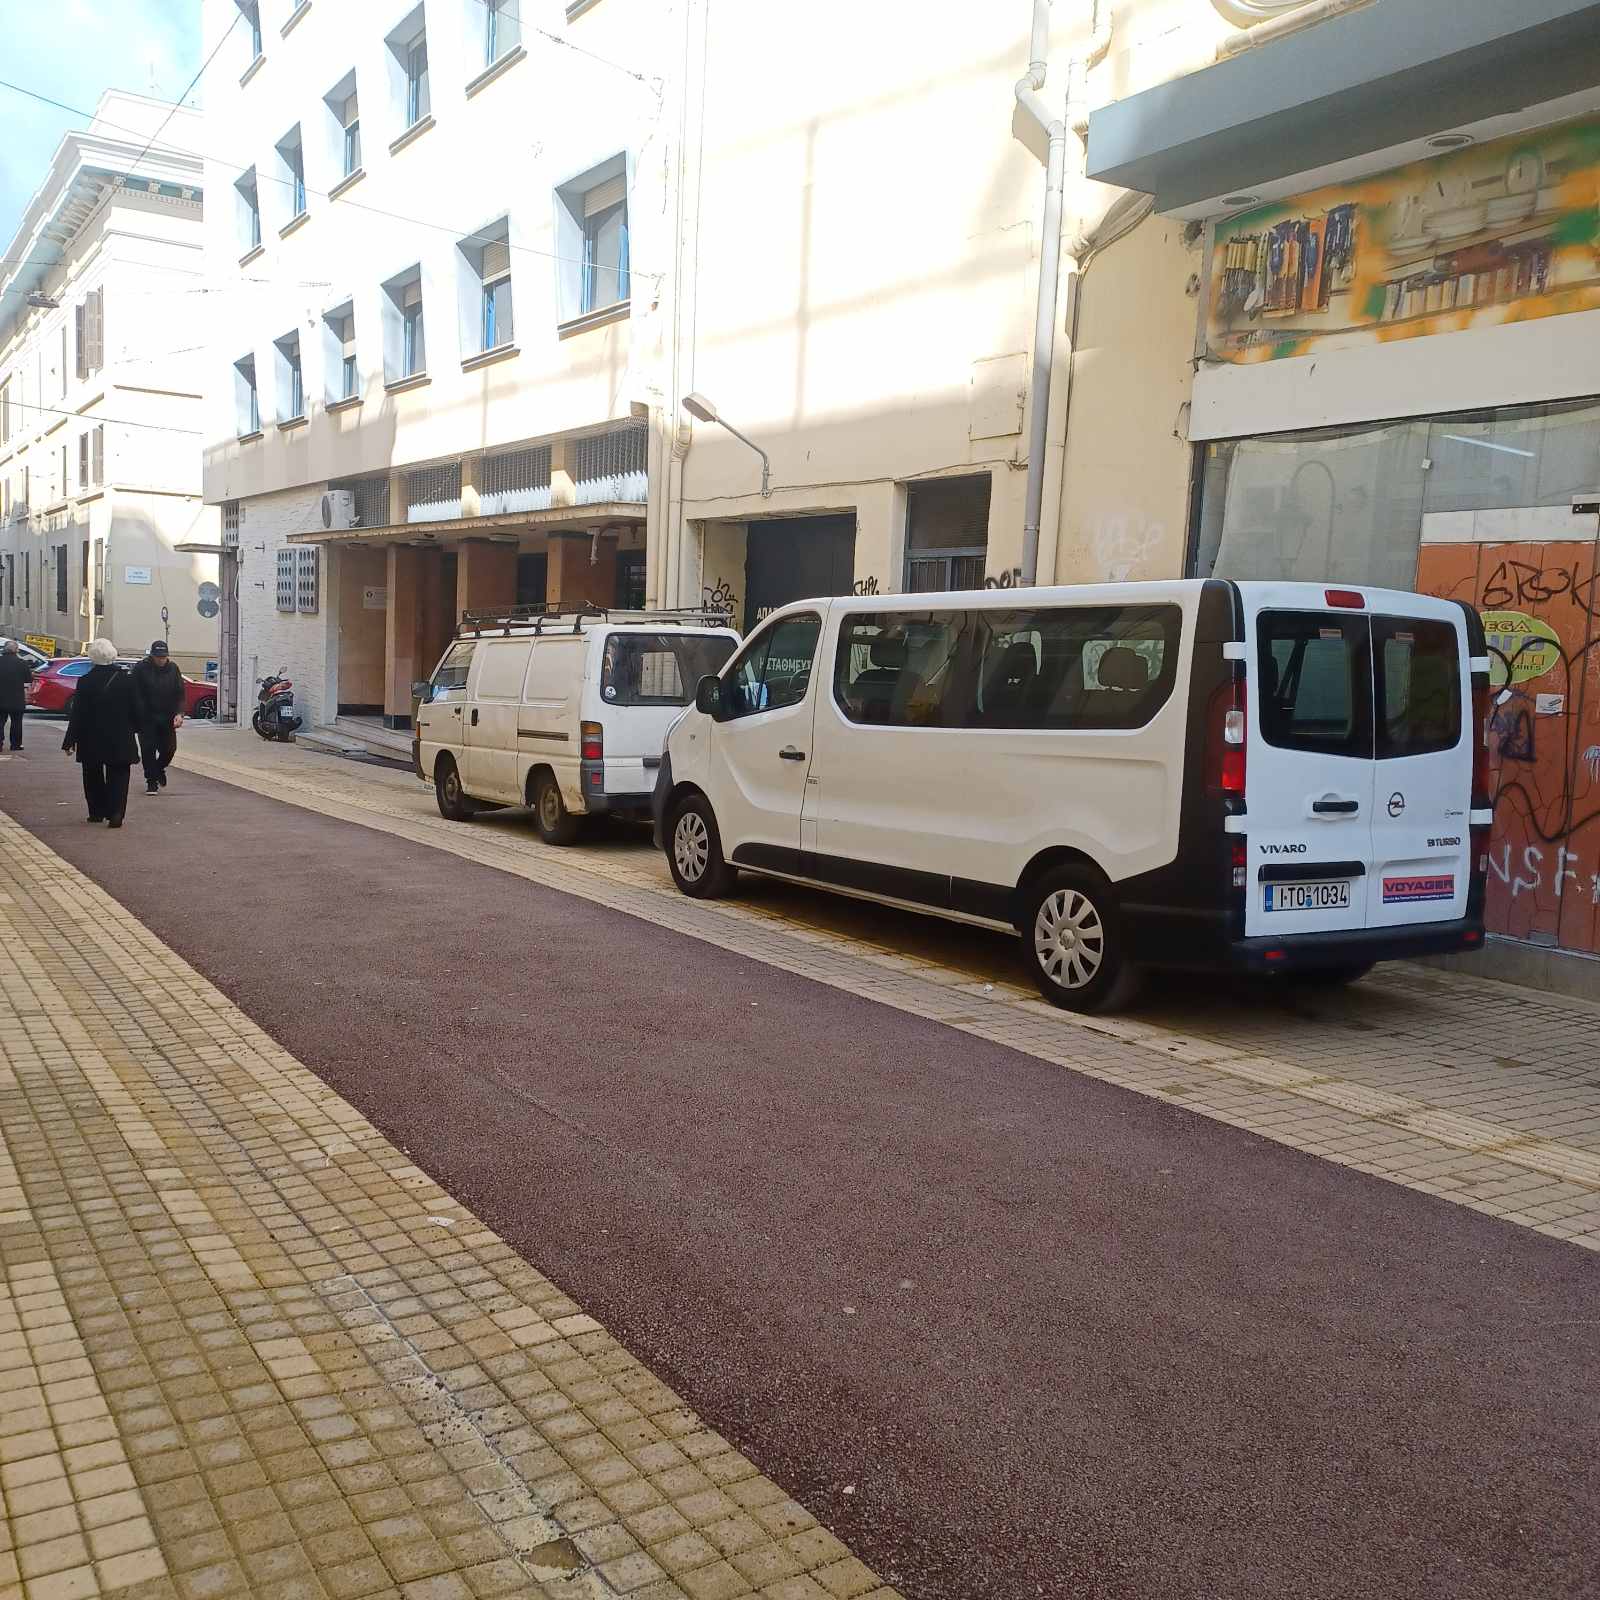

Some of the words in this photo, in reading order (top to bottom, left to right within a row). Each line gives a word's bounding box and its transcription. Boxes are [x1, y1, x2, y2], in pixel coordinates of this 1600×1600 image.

[1484, 620, 1532, 633] EGA
[766, 657, 812, 672] ΣΤΑΘΜΕΥΣ
[1259, 844, 1307, 854] VIVARO
[1384, 879, 1455, 892] VOYAGER
